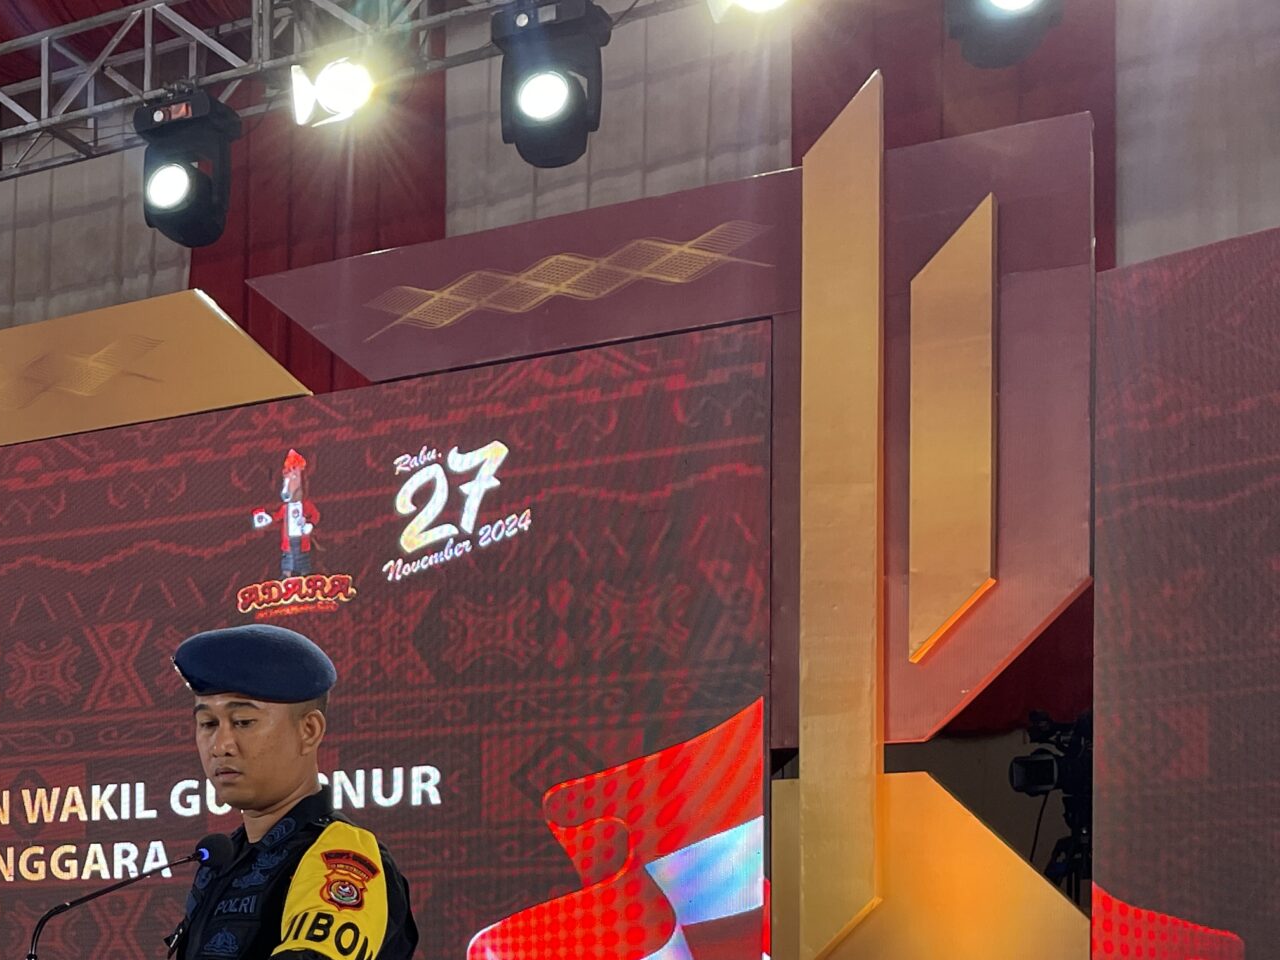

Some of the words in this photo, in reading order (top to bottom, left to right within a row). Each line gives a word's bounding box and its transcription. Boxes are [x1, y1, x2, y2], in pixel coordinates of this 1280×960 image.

[395, 440, 509, 553] 27
[382, 538, 472, 581] November
[478, 509, 532, 547] 2024
[21, 781, 157, 824] WAKIL
[170, 765, 442, 817] GUNUR
